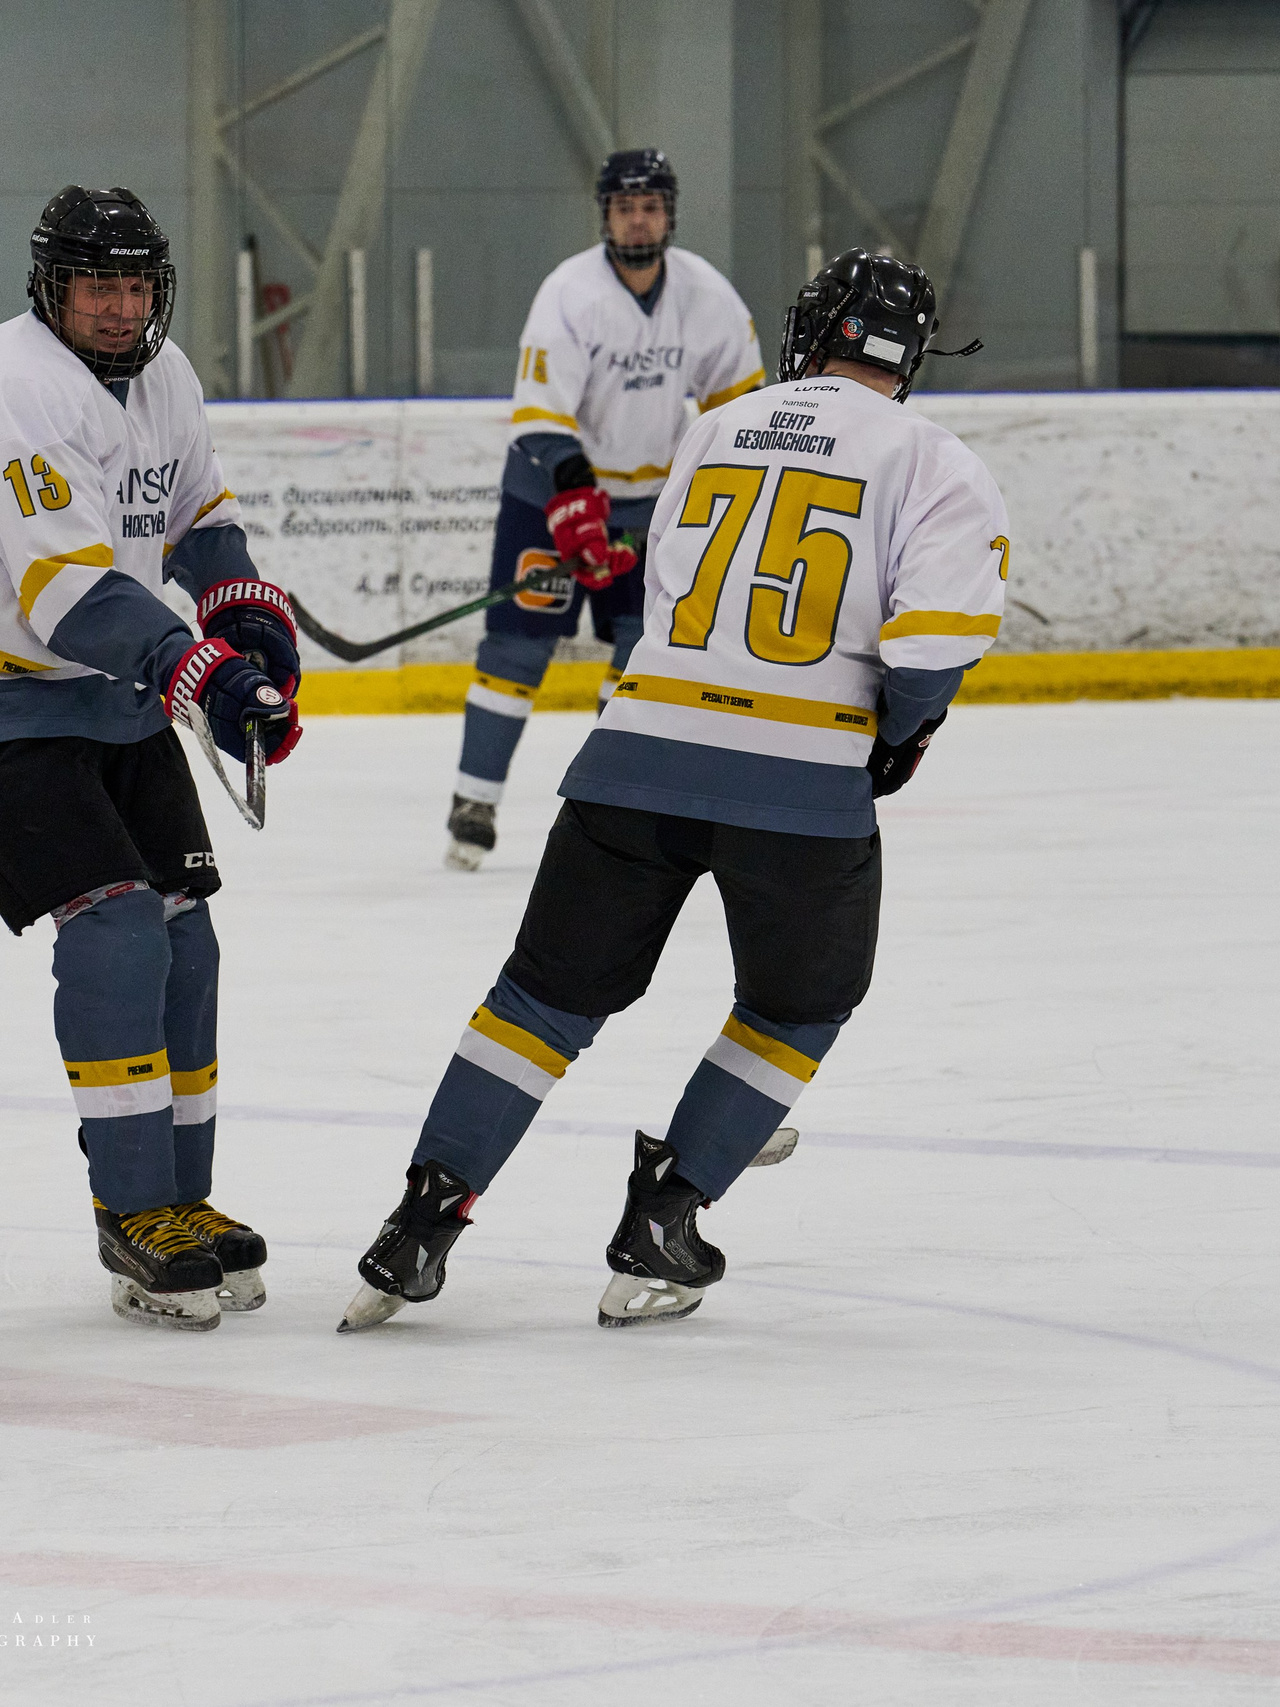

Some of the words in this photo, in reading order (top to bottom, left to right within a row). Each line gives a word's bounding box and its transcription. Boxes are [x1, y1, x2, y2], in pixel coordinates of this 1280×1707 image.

[109, 248, 149, 256] BAUER
[794, 385, 841, 393] LUTCH
[782, 399, 820, 409] hanston
[769, 410, 816, 432] ЦЕНТР
[733, 428, 837, 458] БЕЗОПАСНОСТИ
[3, 453, 73, 518] 13
[668, 463, 868, 667] 75
[730, 697, 755, 709] SERVICE
[127, 1063, 153, 1077] PREMIUM
